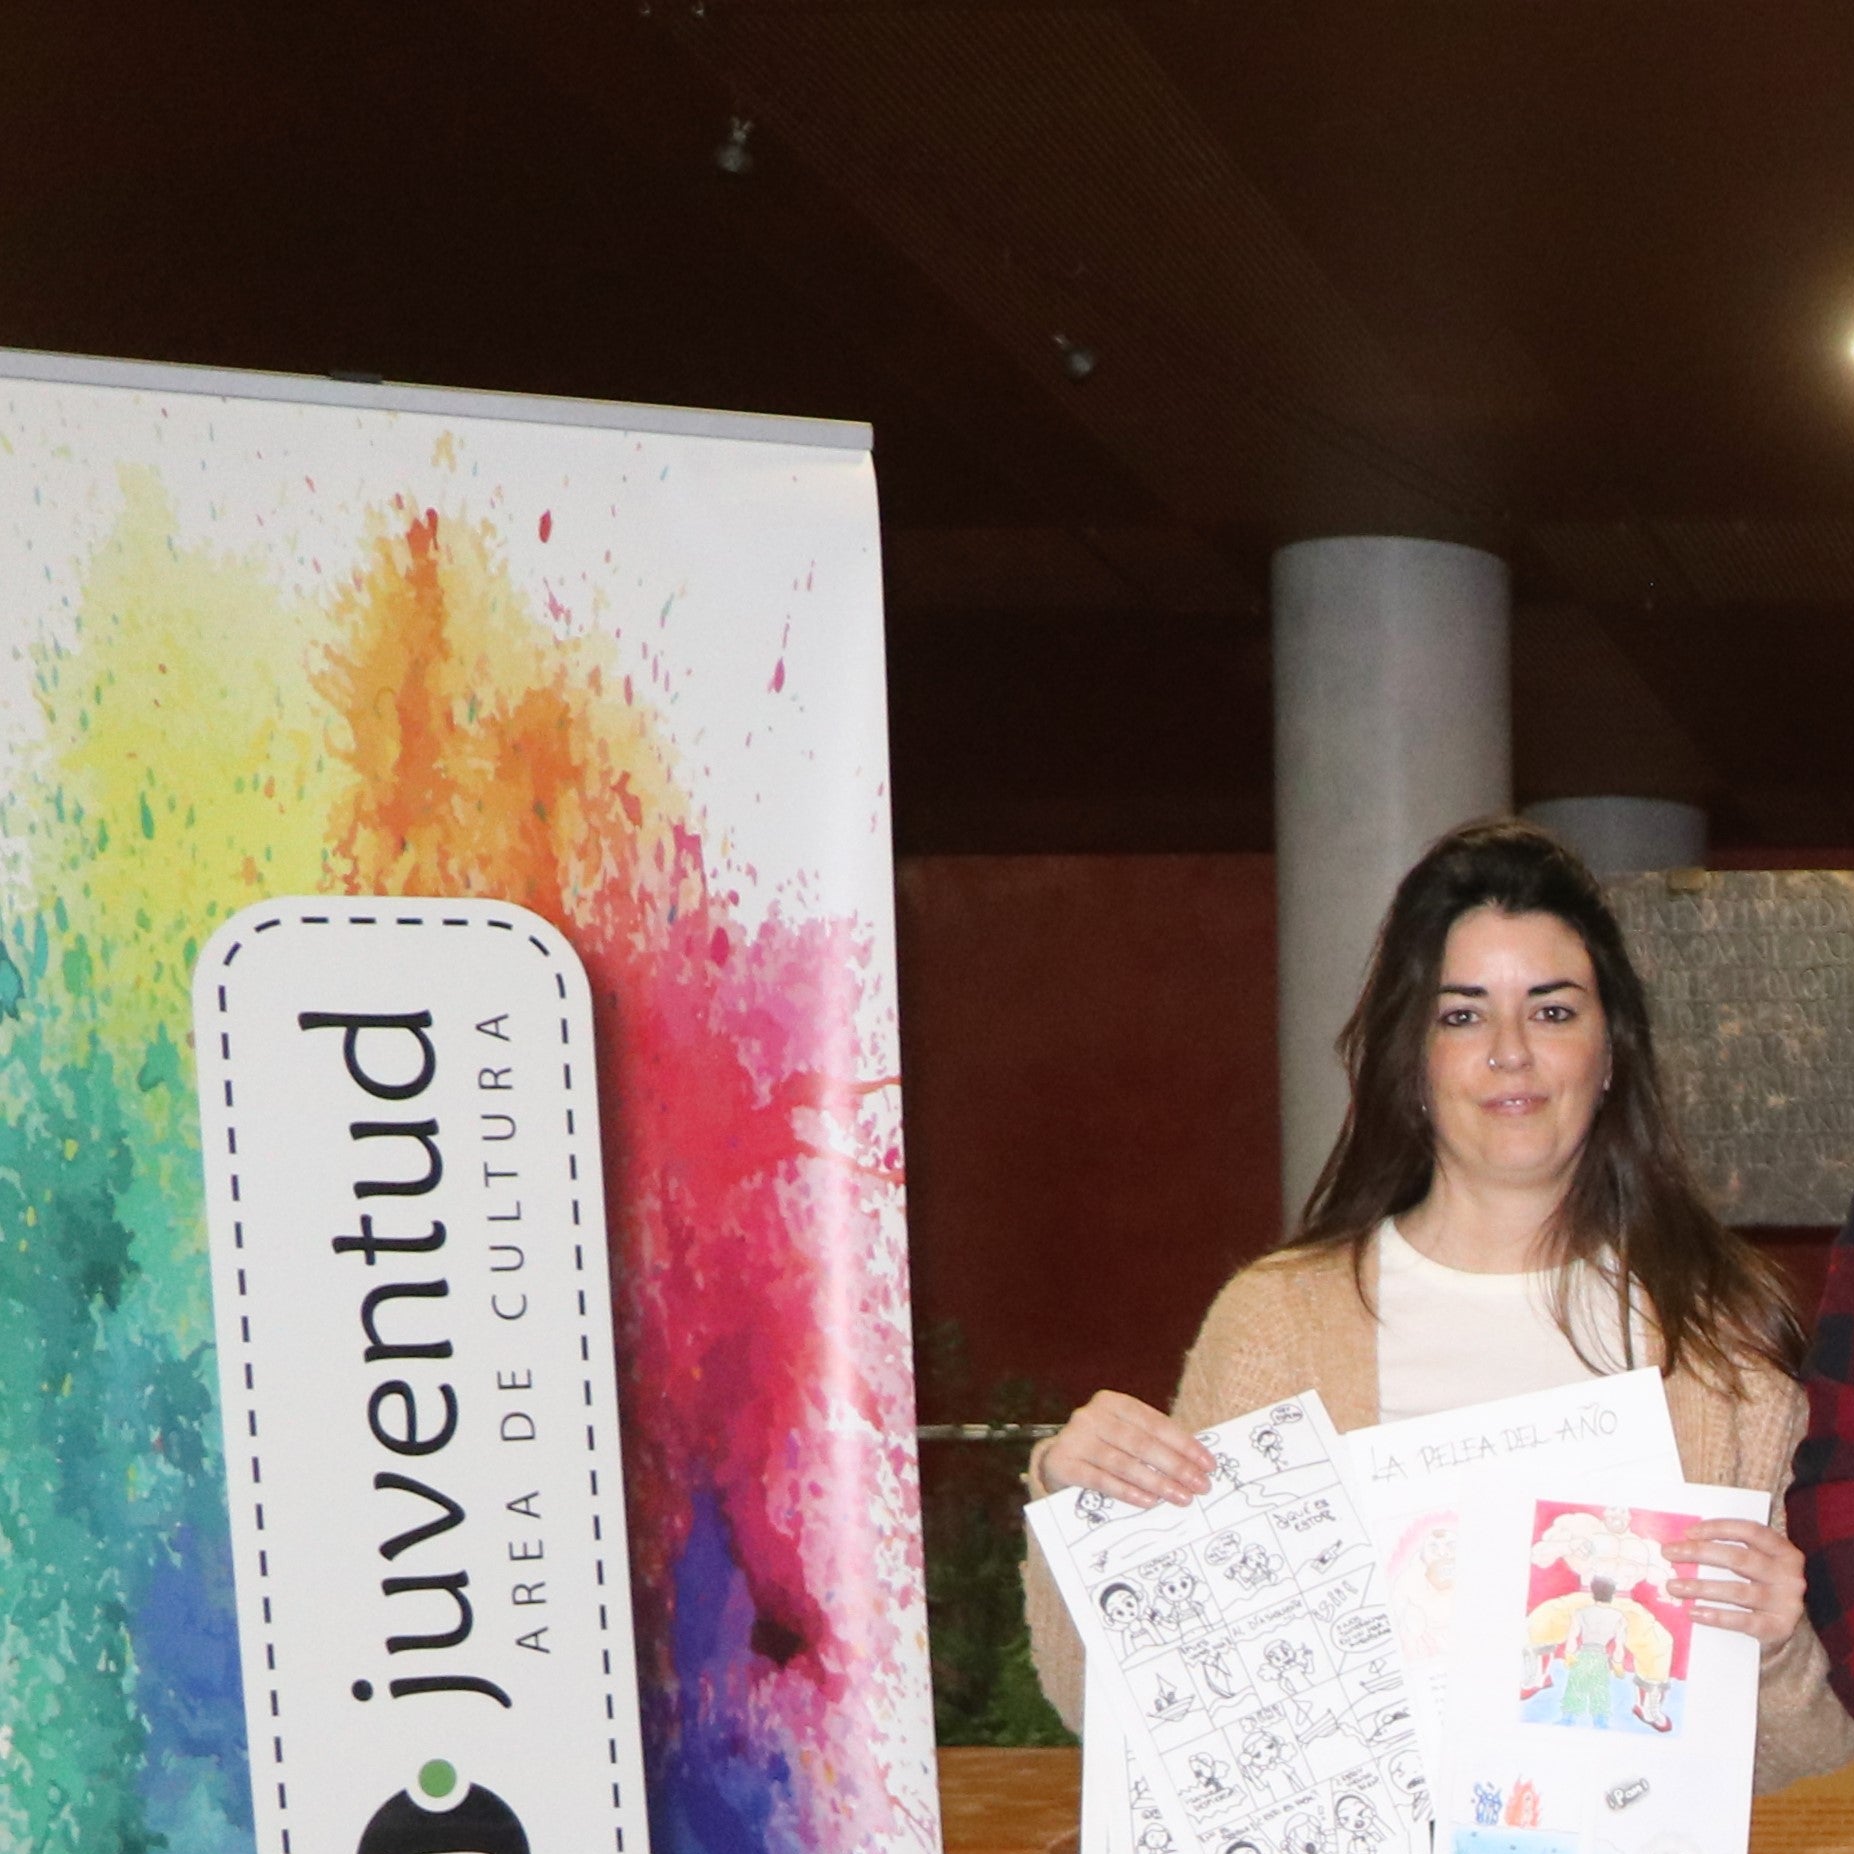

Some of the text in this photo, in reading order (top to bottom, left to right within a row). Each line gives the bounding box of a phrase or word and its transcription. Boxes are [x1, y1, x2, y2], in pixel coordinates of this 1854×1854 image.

[299, 1010, 512, 1710] juventud
[476, 1013, 550, 1656] AREA DE CULTURA
[1371, 1446, 1409, 1482] LA
[1500, 1424, 1550, 1452] DEL
[1554, 1401, 1618, 1442] AÑO
